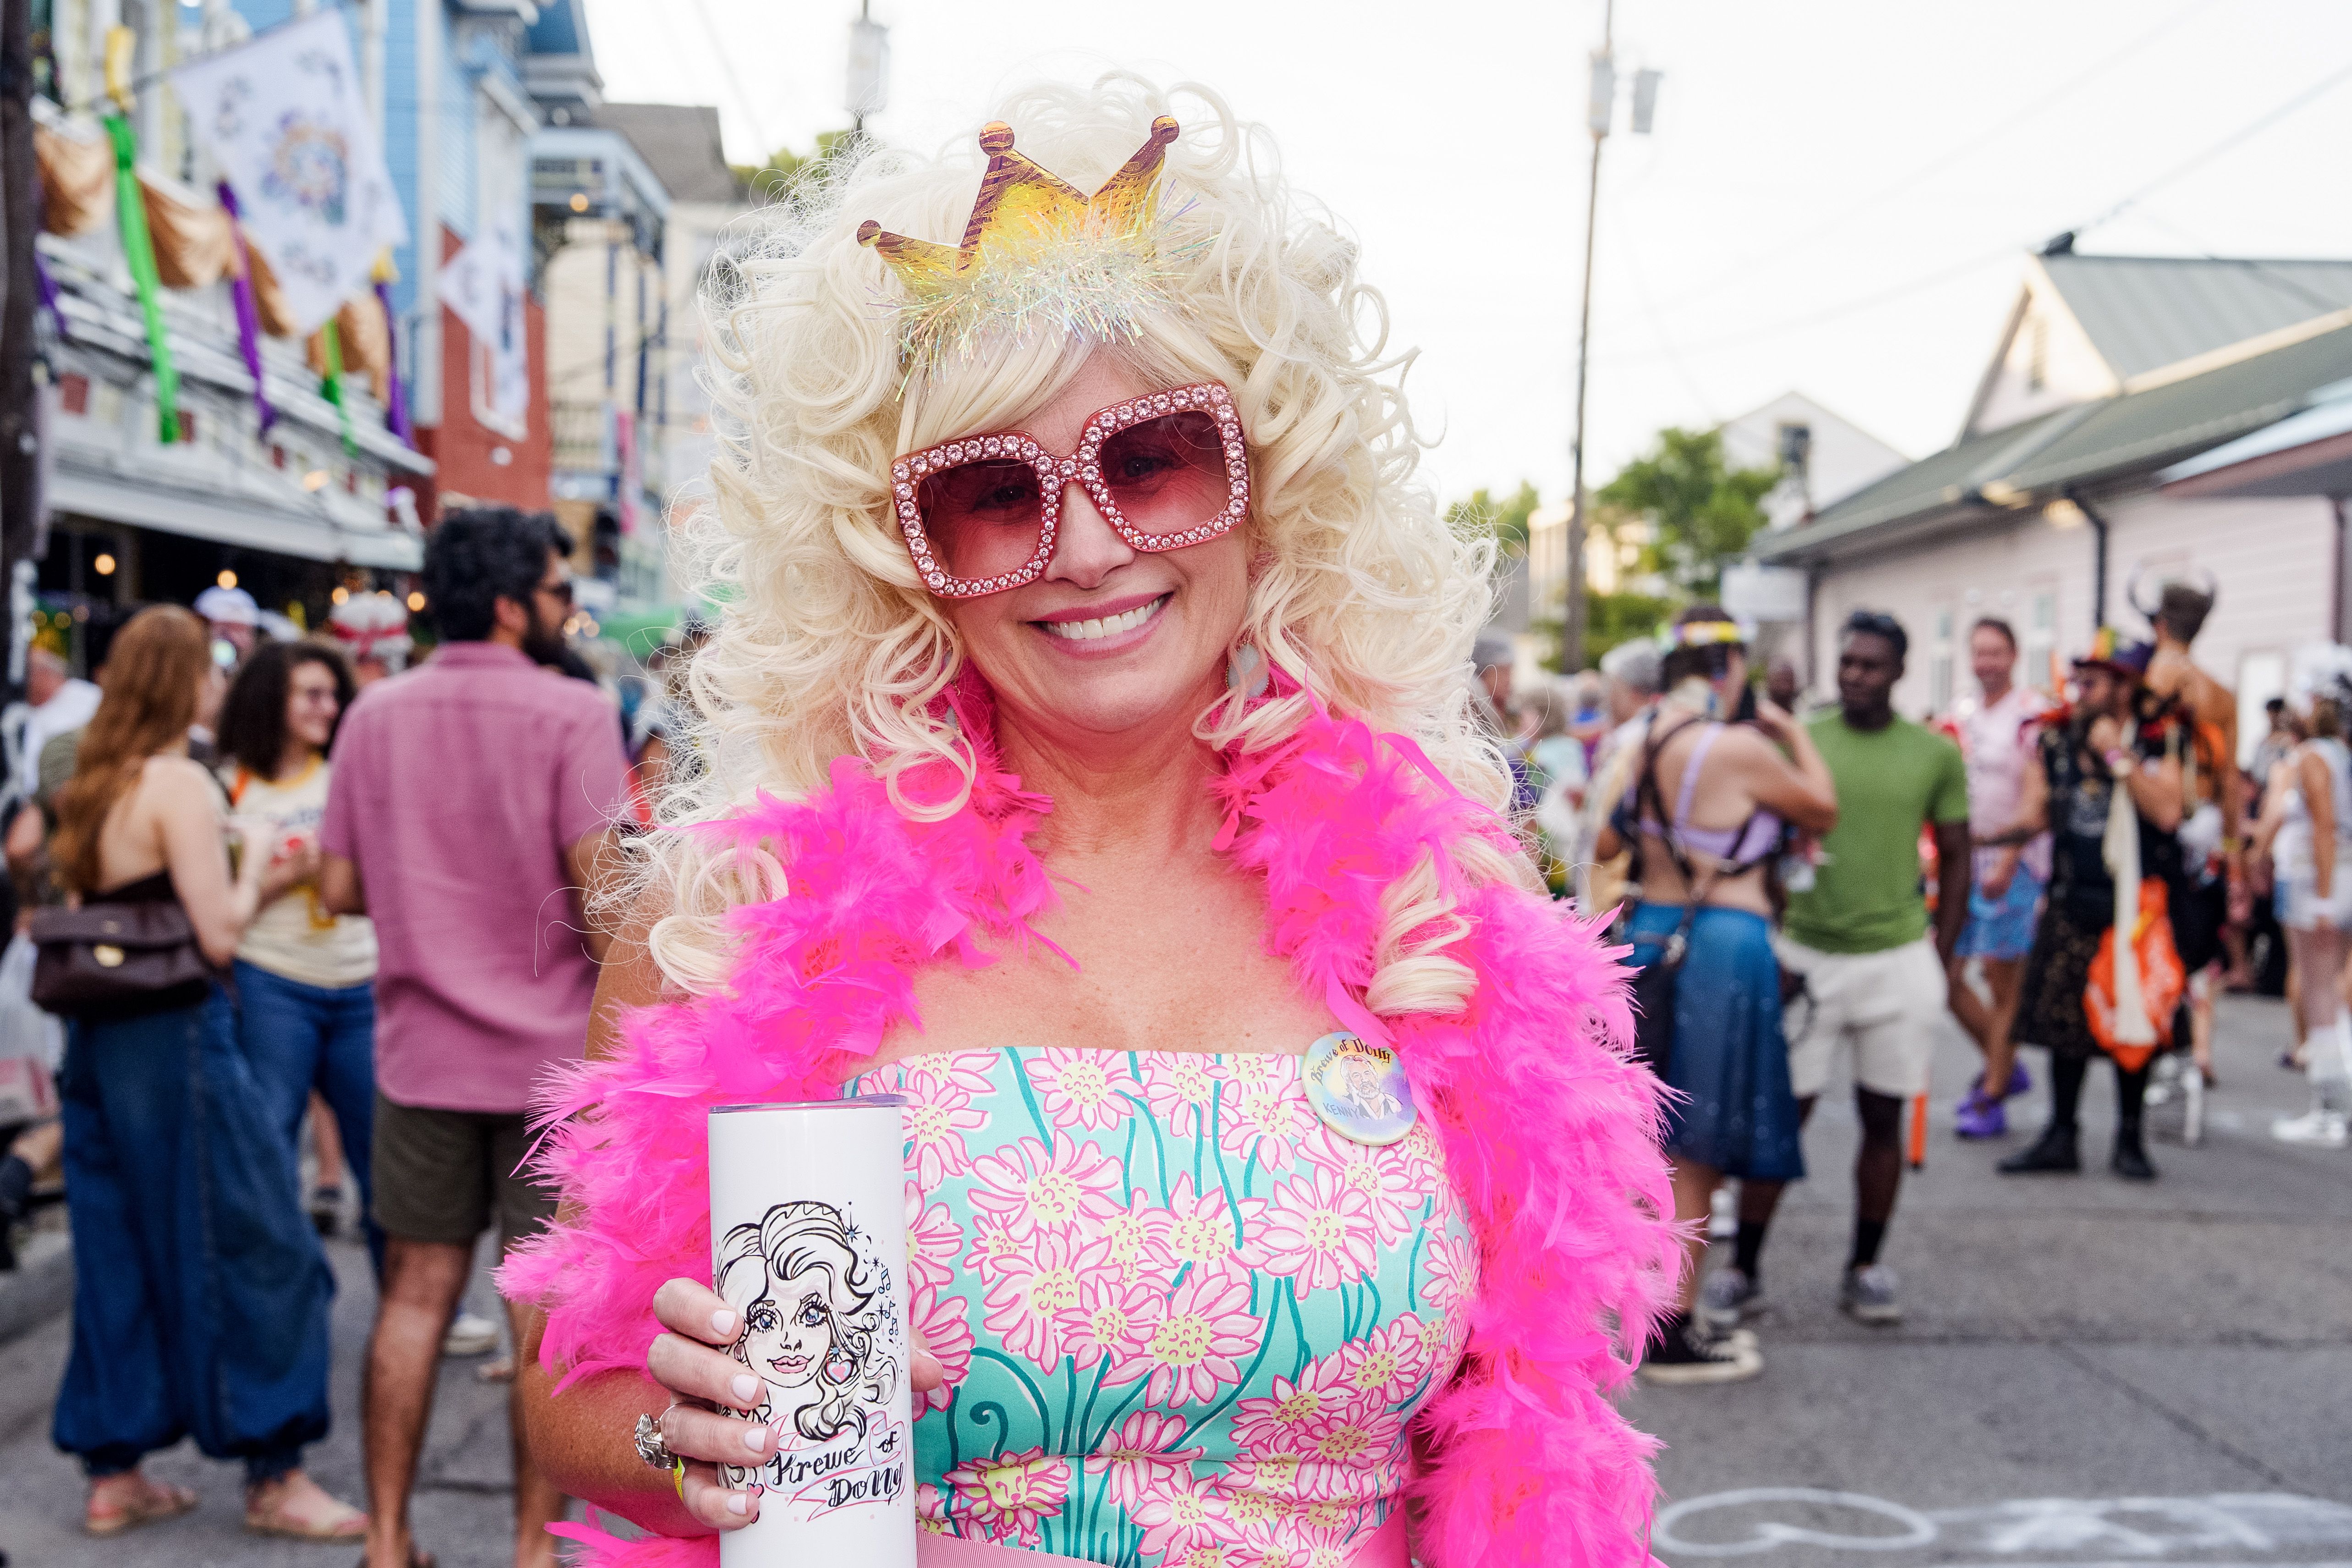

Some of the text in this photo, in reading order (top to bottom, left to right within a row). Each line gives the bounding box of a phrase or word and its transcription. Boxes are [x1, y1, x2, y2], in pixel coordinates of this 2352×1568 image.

[1310, 1048, 1338, 1086] Krewe
[1339, 1039, 1349, 1052] of
[1323, 1102, 1359, 1119] KENNY
[765, 1431, 900, 1486] Krewe of
[824, 1462, 903, 1506] Dolly
